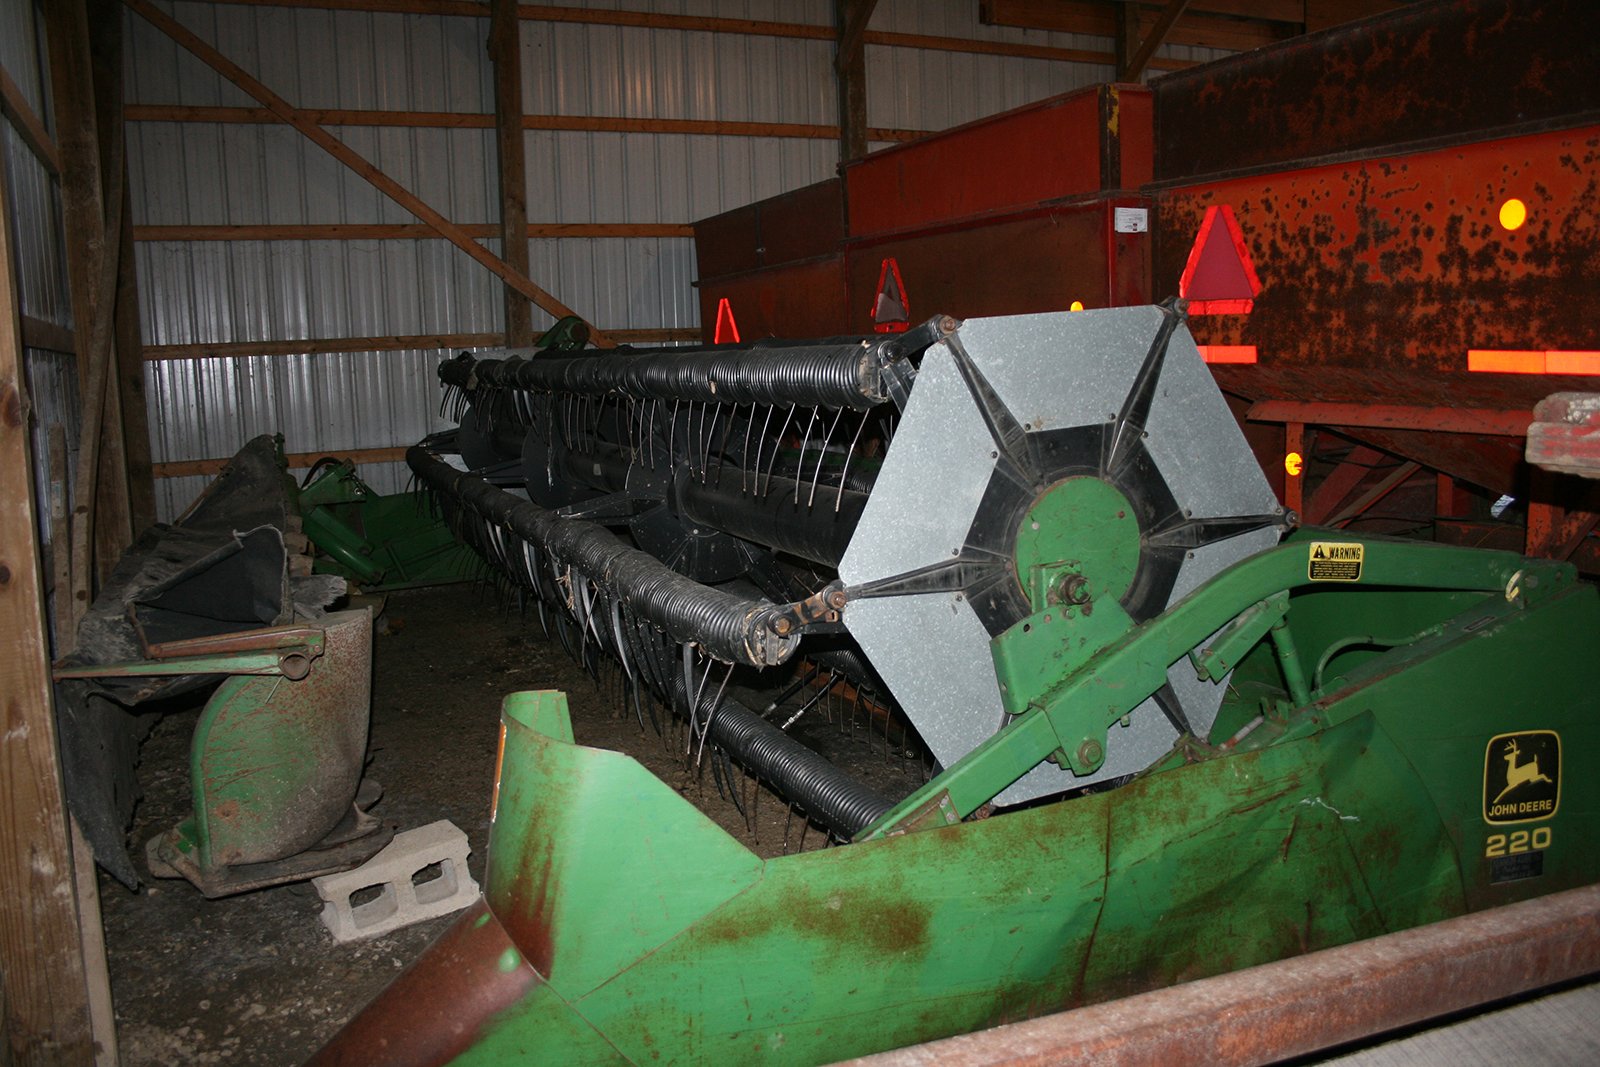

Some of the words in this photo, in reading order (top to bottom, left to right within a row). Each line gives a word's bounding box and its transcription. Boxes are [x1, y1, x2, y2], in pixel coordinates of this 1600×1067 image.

[1329, 547, 1361, 560] WARNING
[1489, 803, 1517, 817] JOHN
[1519, 799, 1552, 813] DEERE
[1486, 826, 1552, 857] 220
